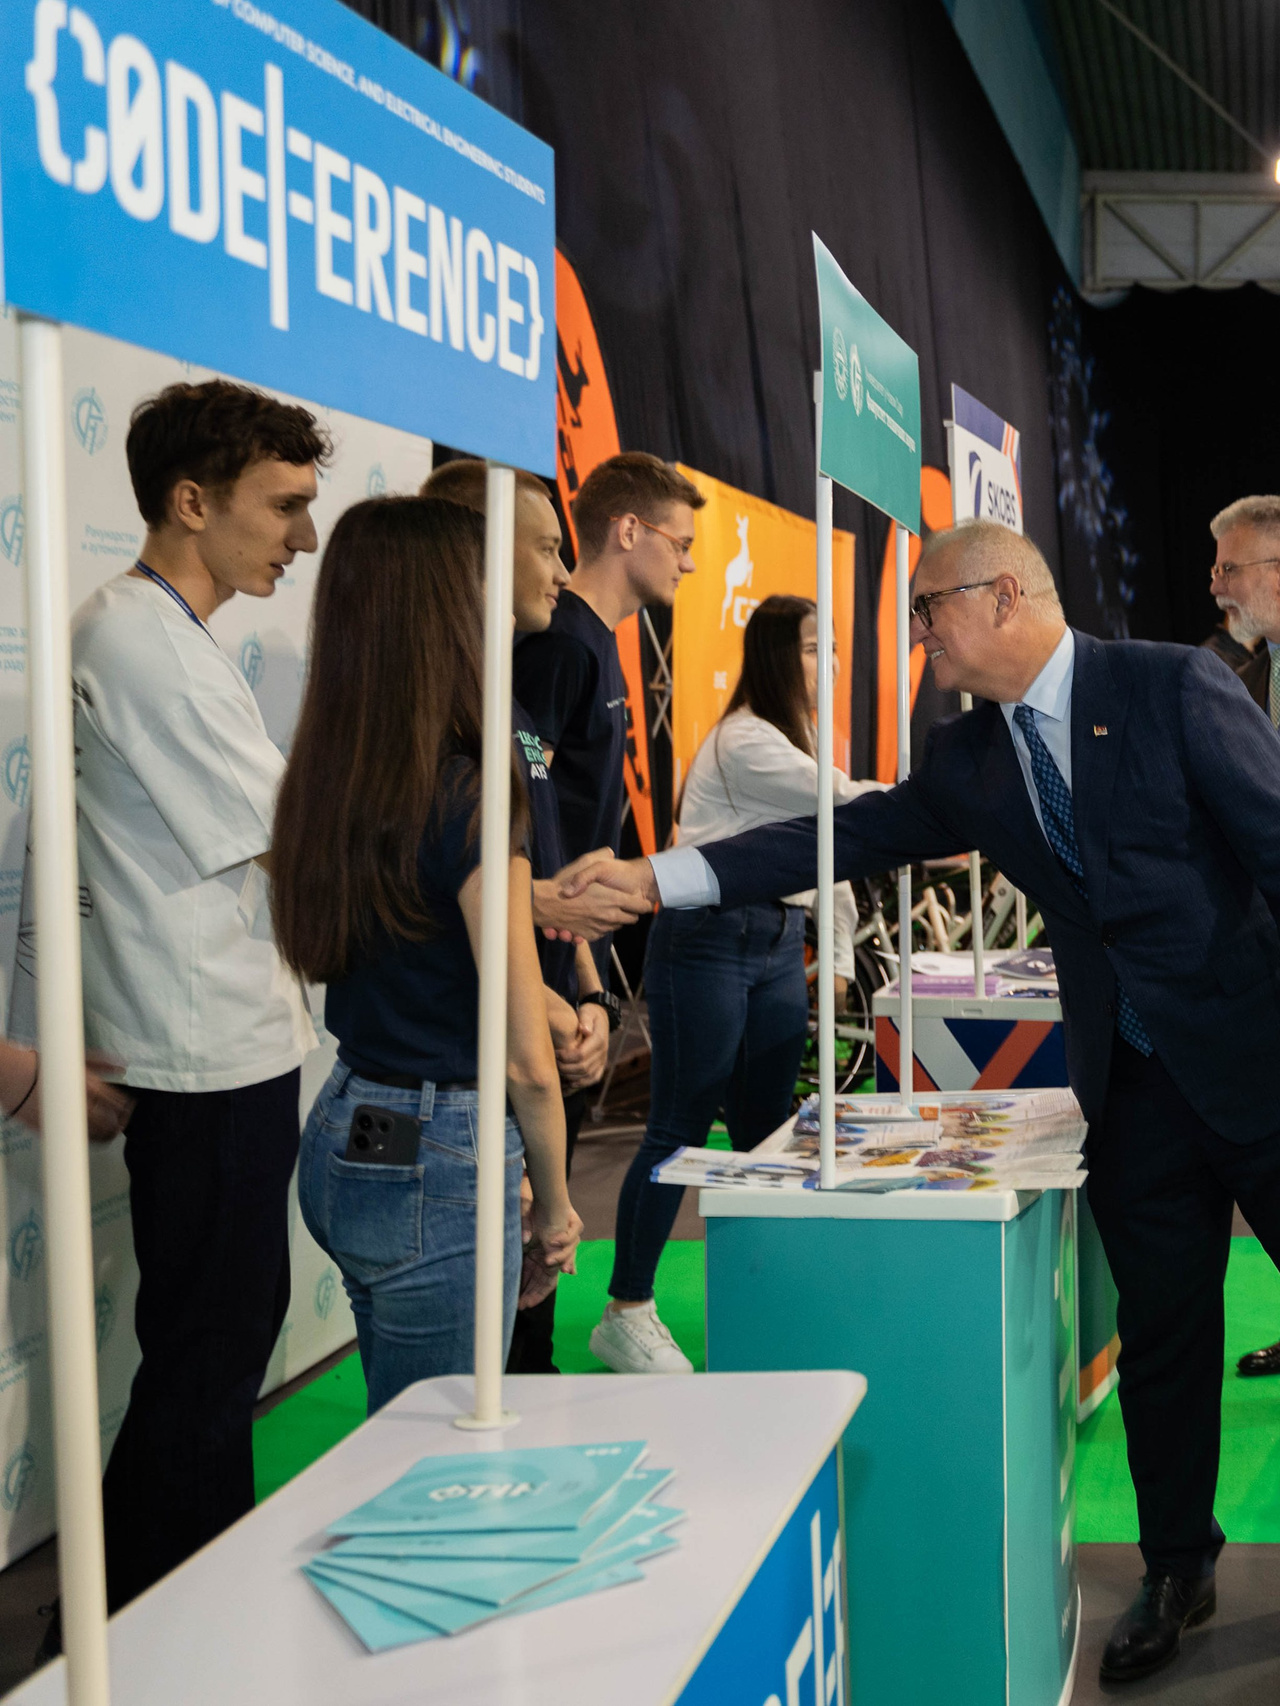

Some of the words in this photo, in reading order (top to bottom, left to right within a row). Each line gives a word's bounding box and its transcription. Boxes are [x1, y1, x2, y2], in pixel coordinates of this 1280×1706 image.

[231, 0, 305, 56] COMPUTER
[357, 75, 385, 105] AND
[384, 90, 443, 142] ELECTRICAL
[441, 125, 505, 180] ENGINEERING
[503, 163, 546, 206] STUDENTS
